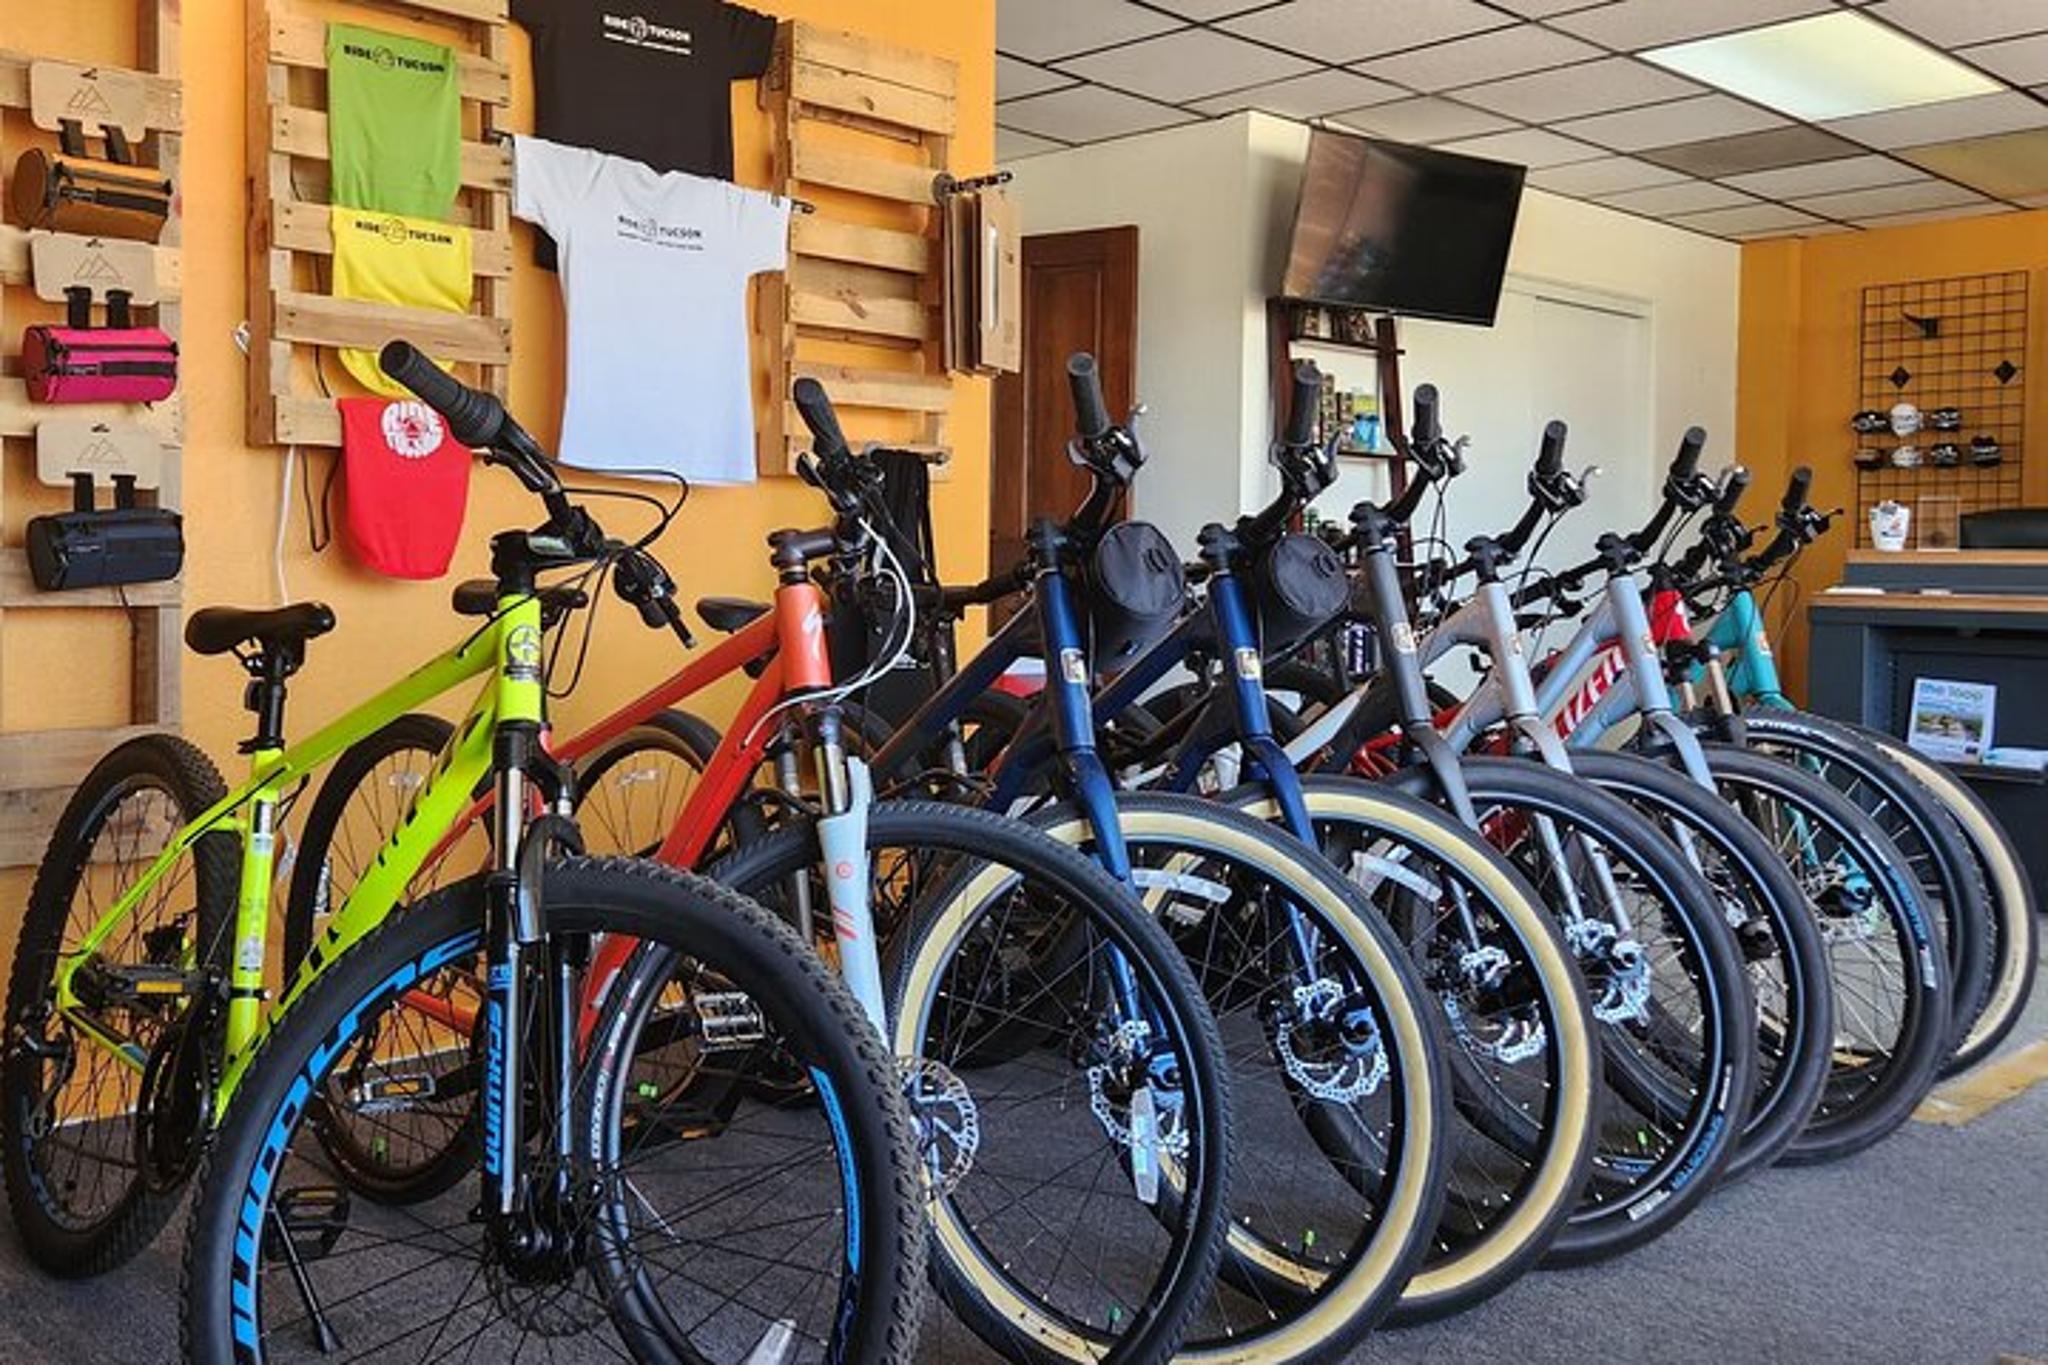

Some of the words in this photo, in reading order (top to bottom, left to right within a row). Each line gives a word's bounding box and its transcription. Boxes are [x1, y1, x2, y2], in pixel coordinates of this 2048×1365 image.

[648, 24, 692, 42] TUCSON
[396, 55, 446, 73] TUCSON
[408, 229, 454, 245] TUCSON
[659, 226, 702, 240] TUCSON
[484, 1000, 503, 1176] SCHWINN
